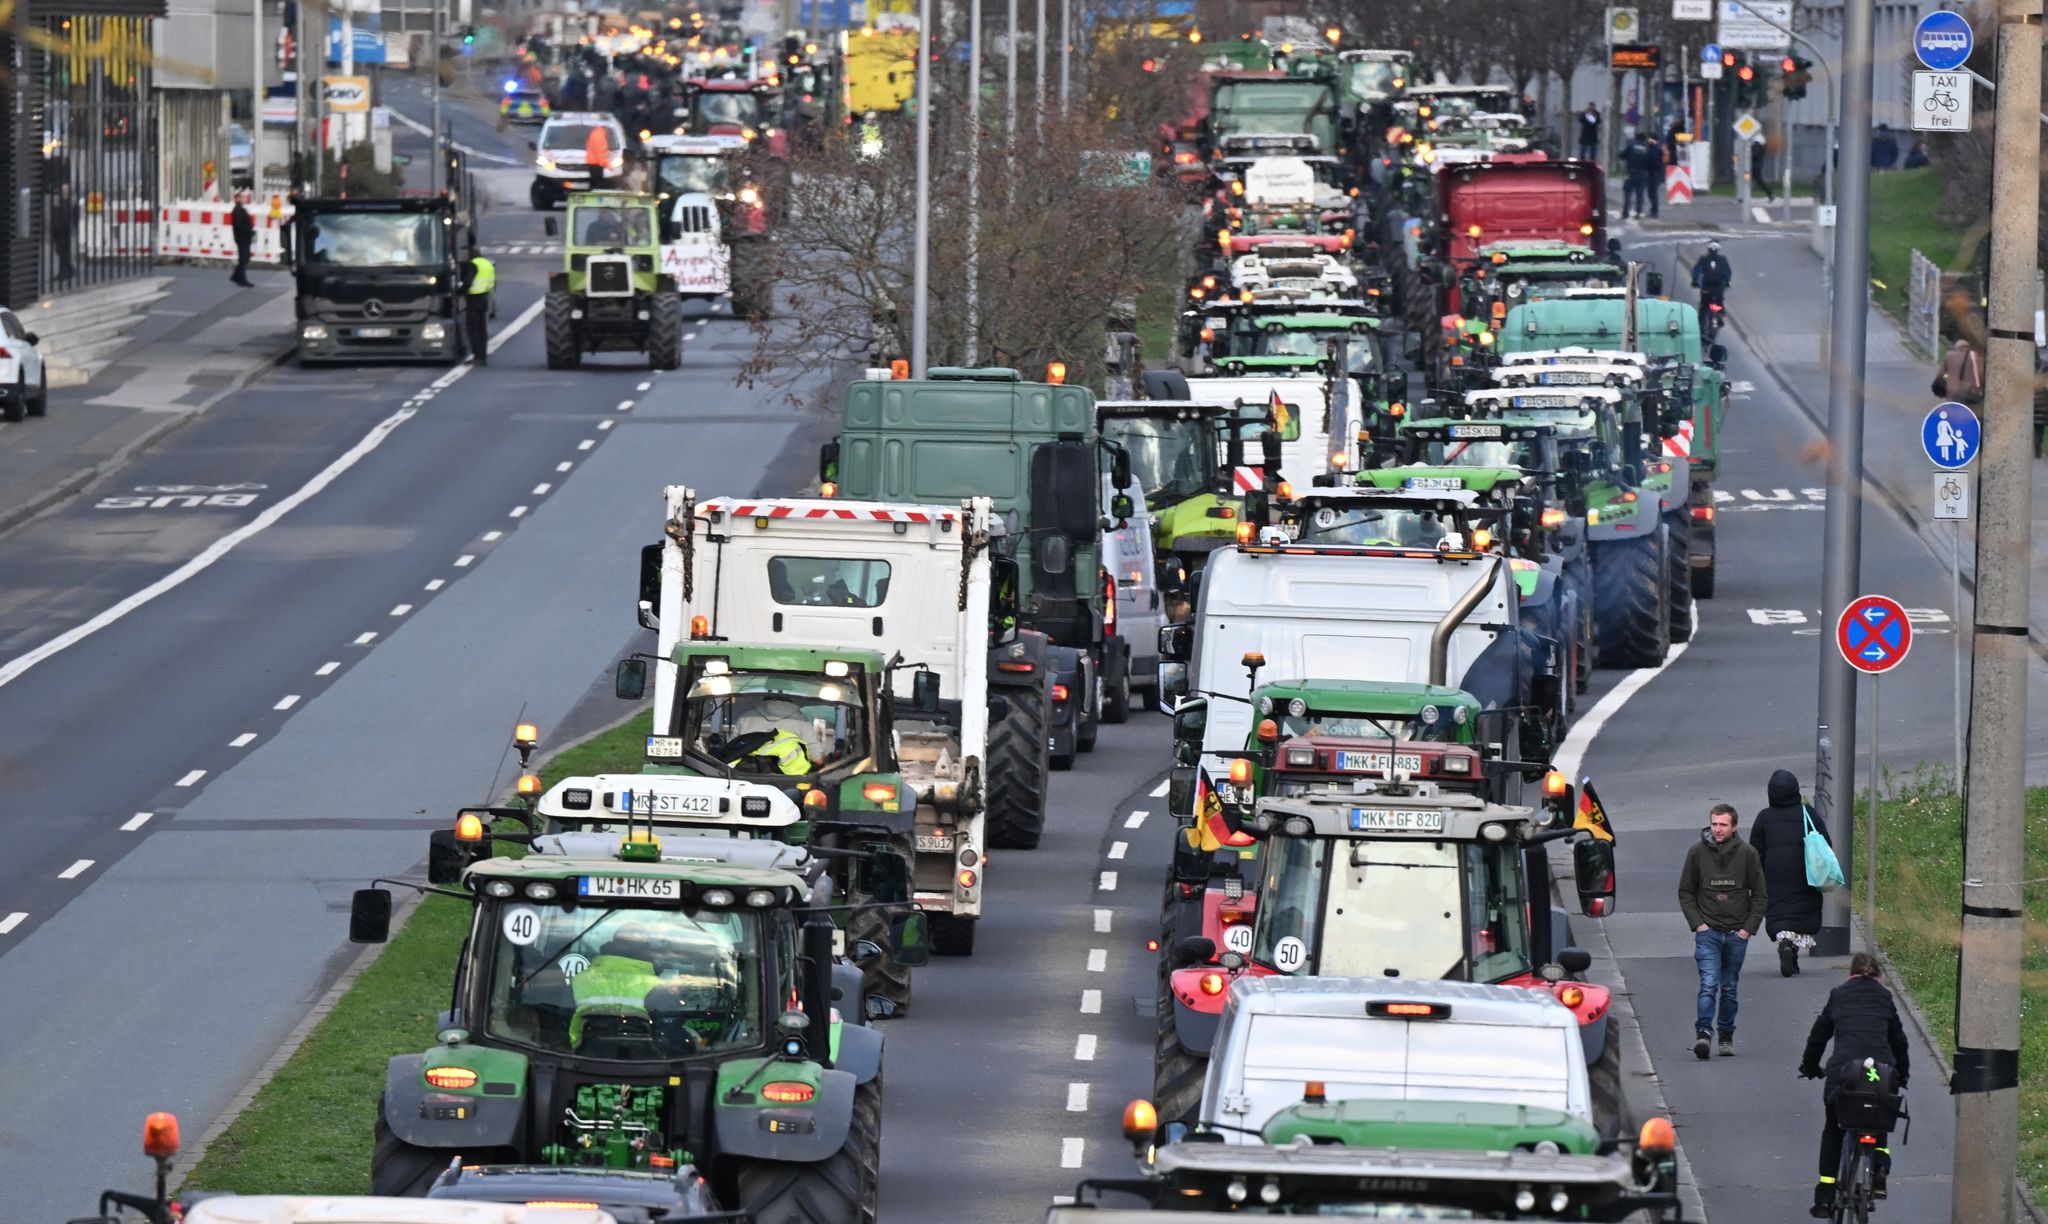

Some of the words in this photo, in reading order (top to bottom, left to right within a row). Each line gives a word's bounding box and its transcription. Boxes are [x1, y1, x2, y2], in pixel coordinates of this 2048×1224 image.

[1929, 75, 1957, 88] TAXI
[1931, 115, 1952, 126] frei
[94, 494, 259, 509] BUS
[1945, 504, 1957, 514] frei
[1320, 512, 1331, 524] 40
[655, 739, 666, 747] MR
[650, 747, 661, 756] KB
[663, 748, 679, 756] 784
[1345, 755, 1369, 769] MKK
[1379, 757, 1392, 769] FL
[1398, 758, 1420, 771] 883
[632, 793, 651, 809] MR
[660, 797, 678, 810] ST
[682, 798, 708, 811] 412
[1362, 812, 1386, 825] MKK
[1397, 813, 1412, 826] GF
[1416, 814, 1440, 827] 820
[596, 878, 616, 893] WI
[627, 879, 647, 894] HK
[652, 880, 672, 895] 65
[512, 915, 533, 938] 40
[1230, 930, 1250, 948] 40
[1280, 944, 1299, 965] 50
